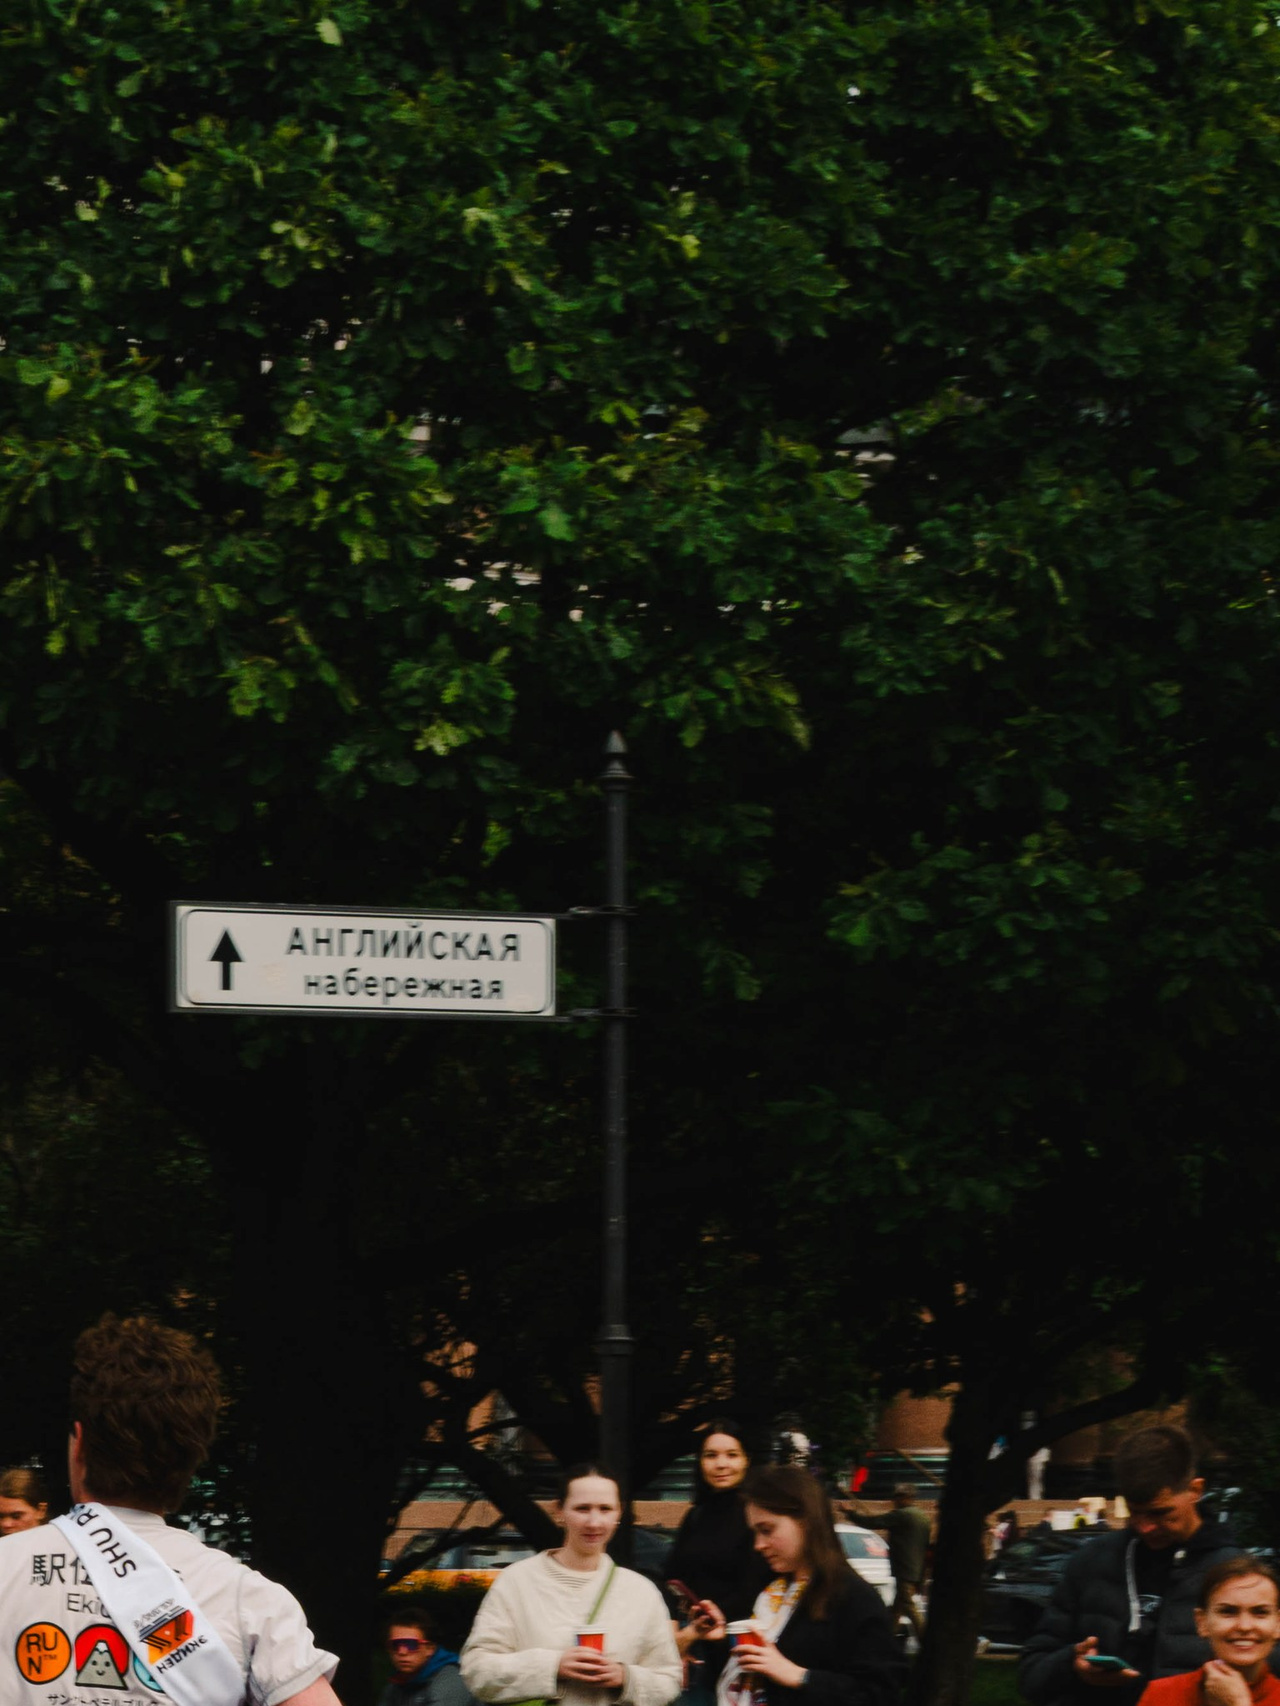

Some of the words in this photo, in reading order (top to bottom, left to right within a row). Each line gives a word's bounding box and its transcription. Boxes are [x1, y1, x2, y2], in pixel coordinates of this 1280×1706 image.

[285, 921, 521, 961] АНГЛИЙСКАЯ
[303, 967, 504, 1005] набережная
[88, 1527, 137, 1578] SHU
[156, 1635, 208, 1674] ЭКИДЕН
